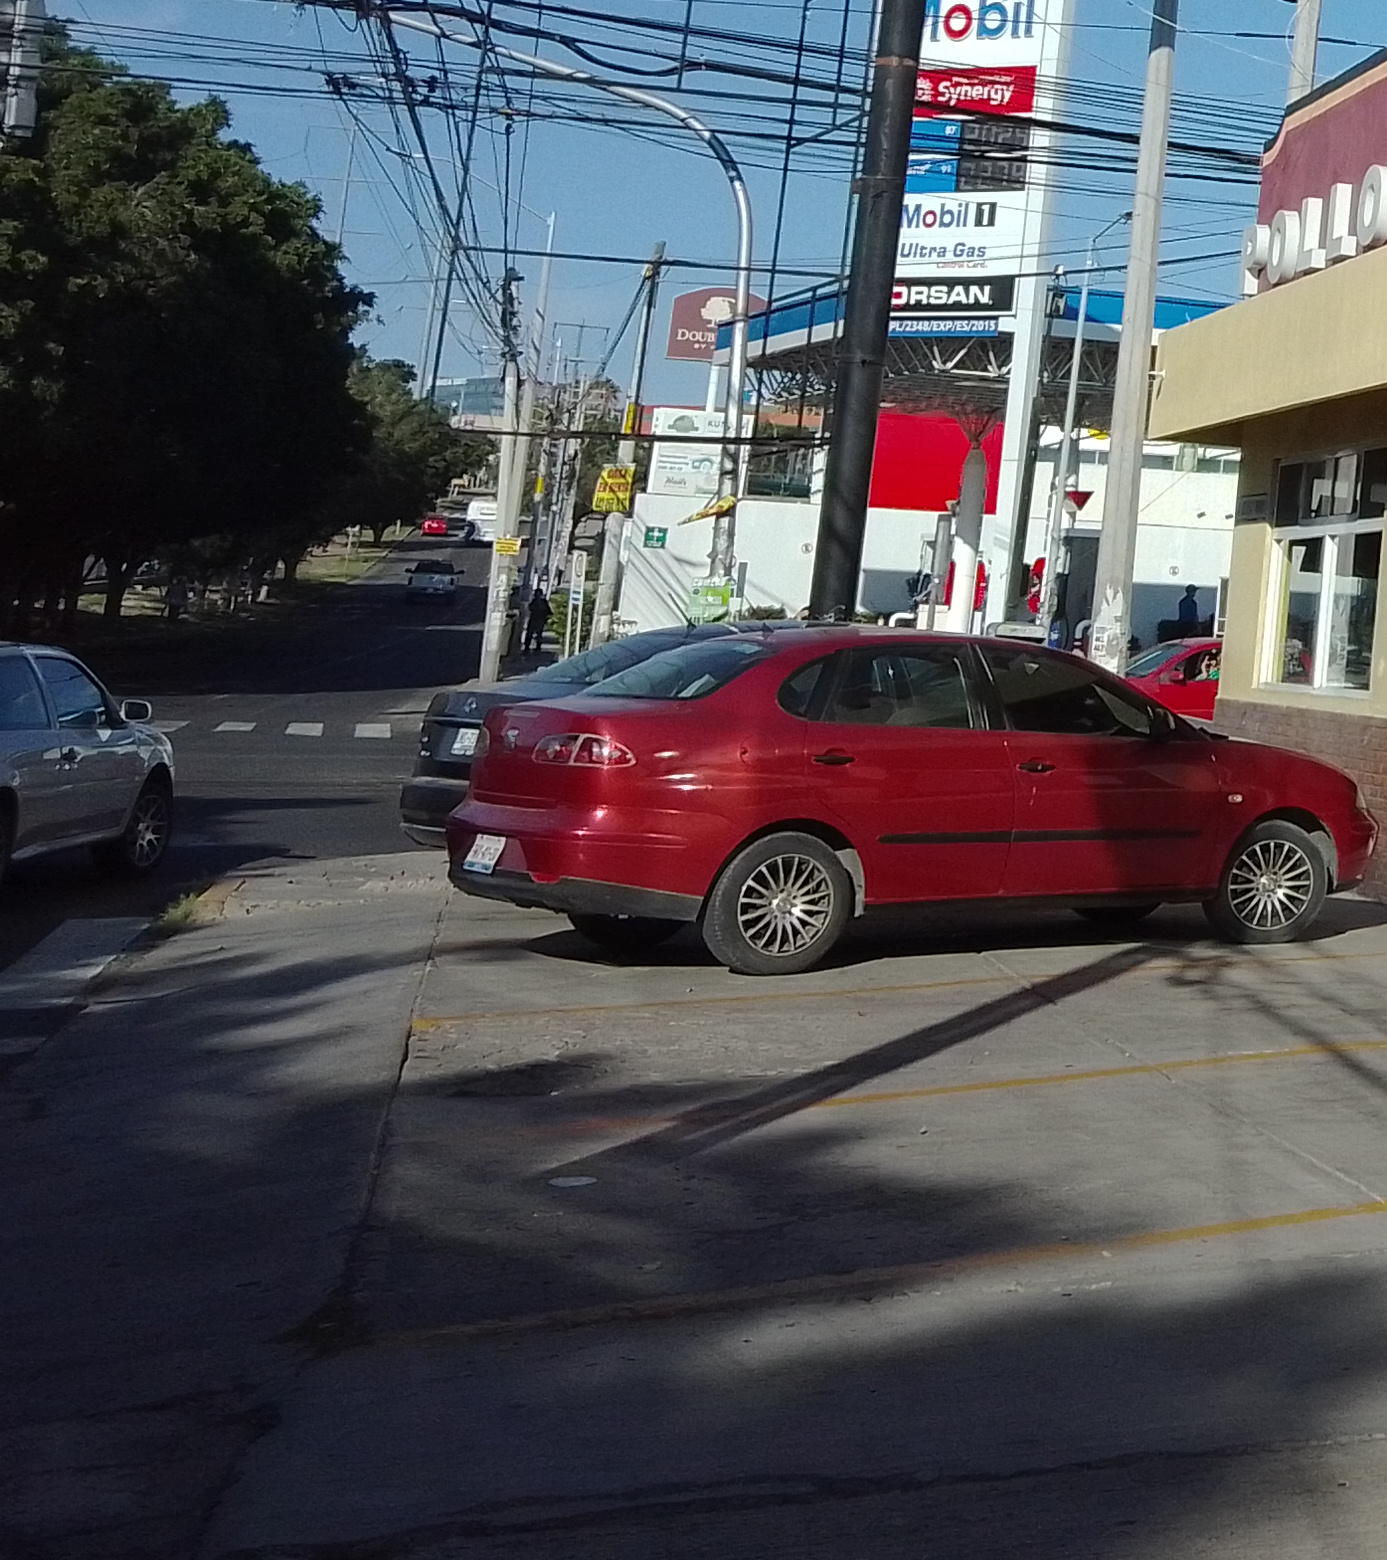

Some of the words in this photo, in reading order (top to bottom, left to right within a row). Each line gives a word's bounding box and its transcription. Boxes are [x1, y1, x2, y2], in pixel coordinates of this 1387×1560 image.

[937, 80, 1015, 106] Synergy
[902, 201, 970, 228] Mobil
[900, 242, 947, 259] Ultra
[953, 242, 988, 258] Gas
